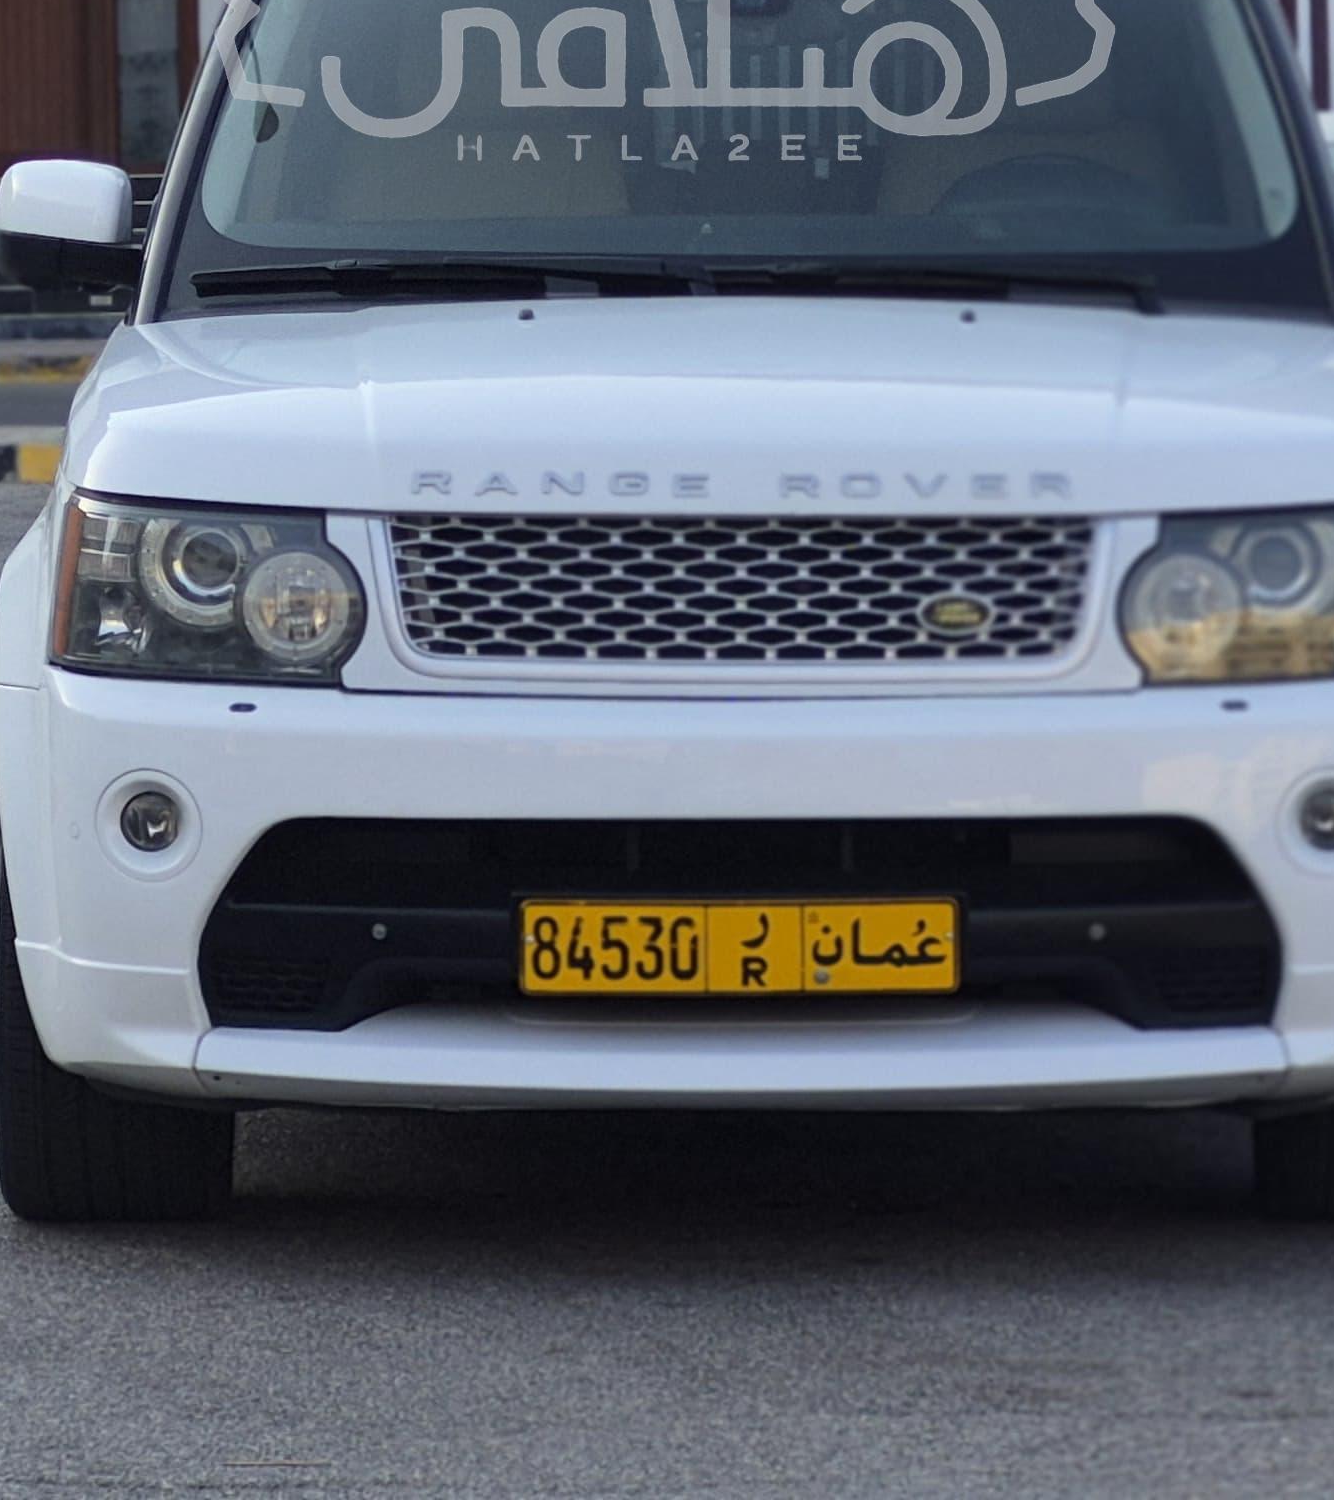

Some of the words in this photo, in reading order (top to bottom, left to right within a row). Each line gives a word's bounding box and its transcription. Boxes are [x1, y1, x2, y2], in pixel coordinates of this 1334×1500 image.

[410, 471, 711, 499] RANGE
[778, 471, 1075, 500] ROVER
[531, 915, 699, 981] 84530
[740, 913, 769, 950] ر
[740, 956, 768, 987] R
